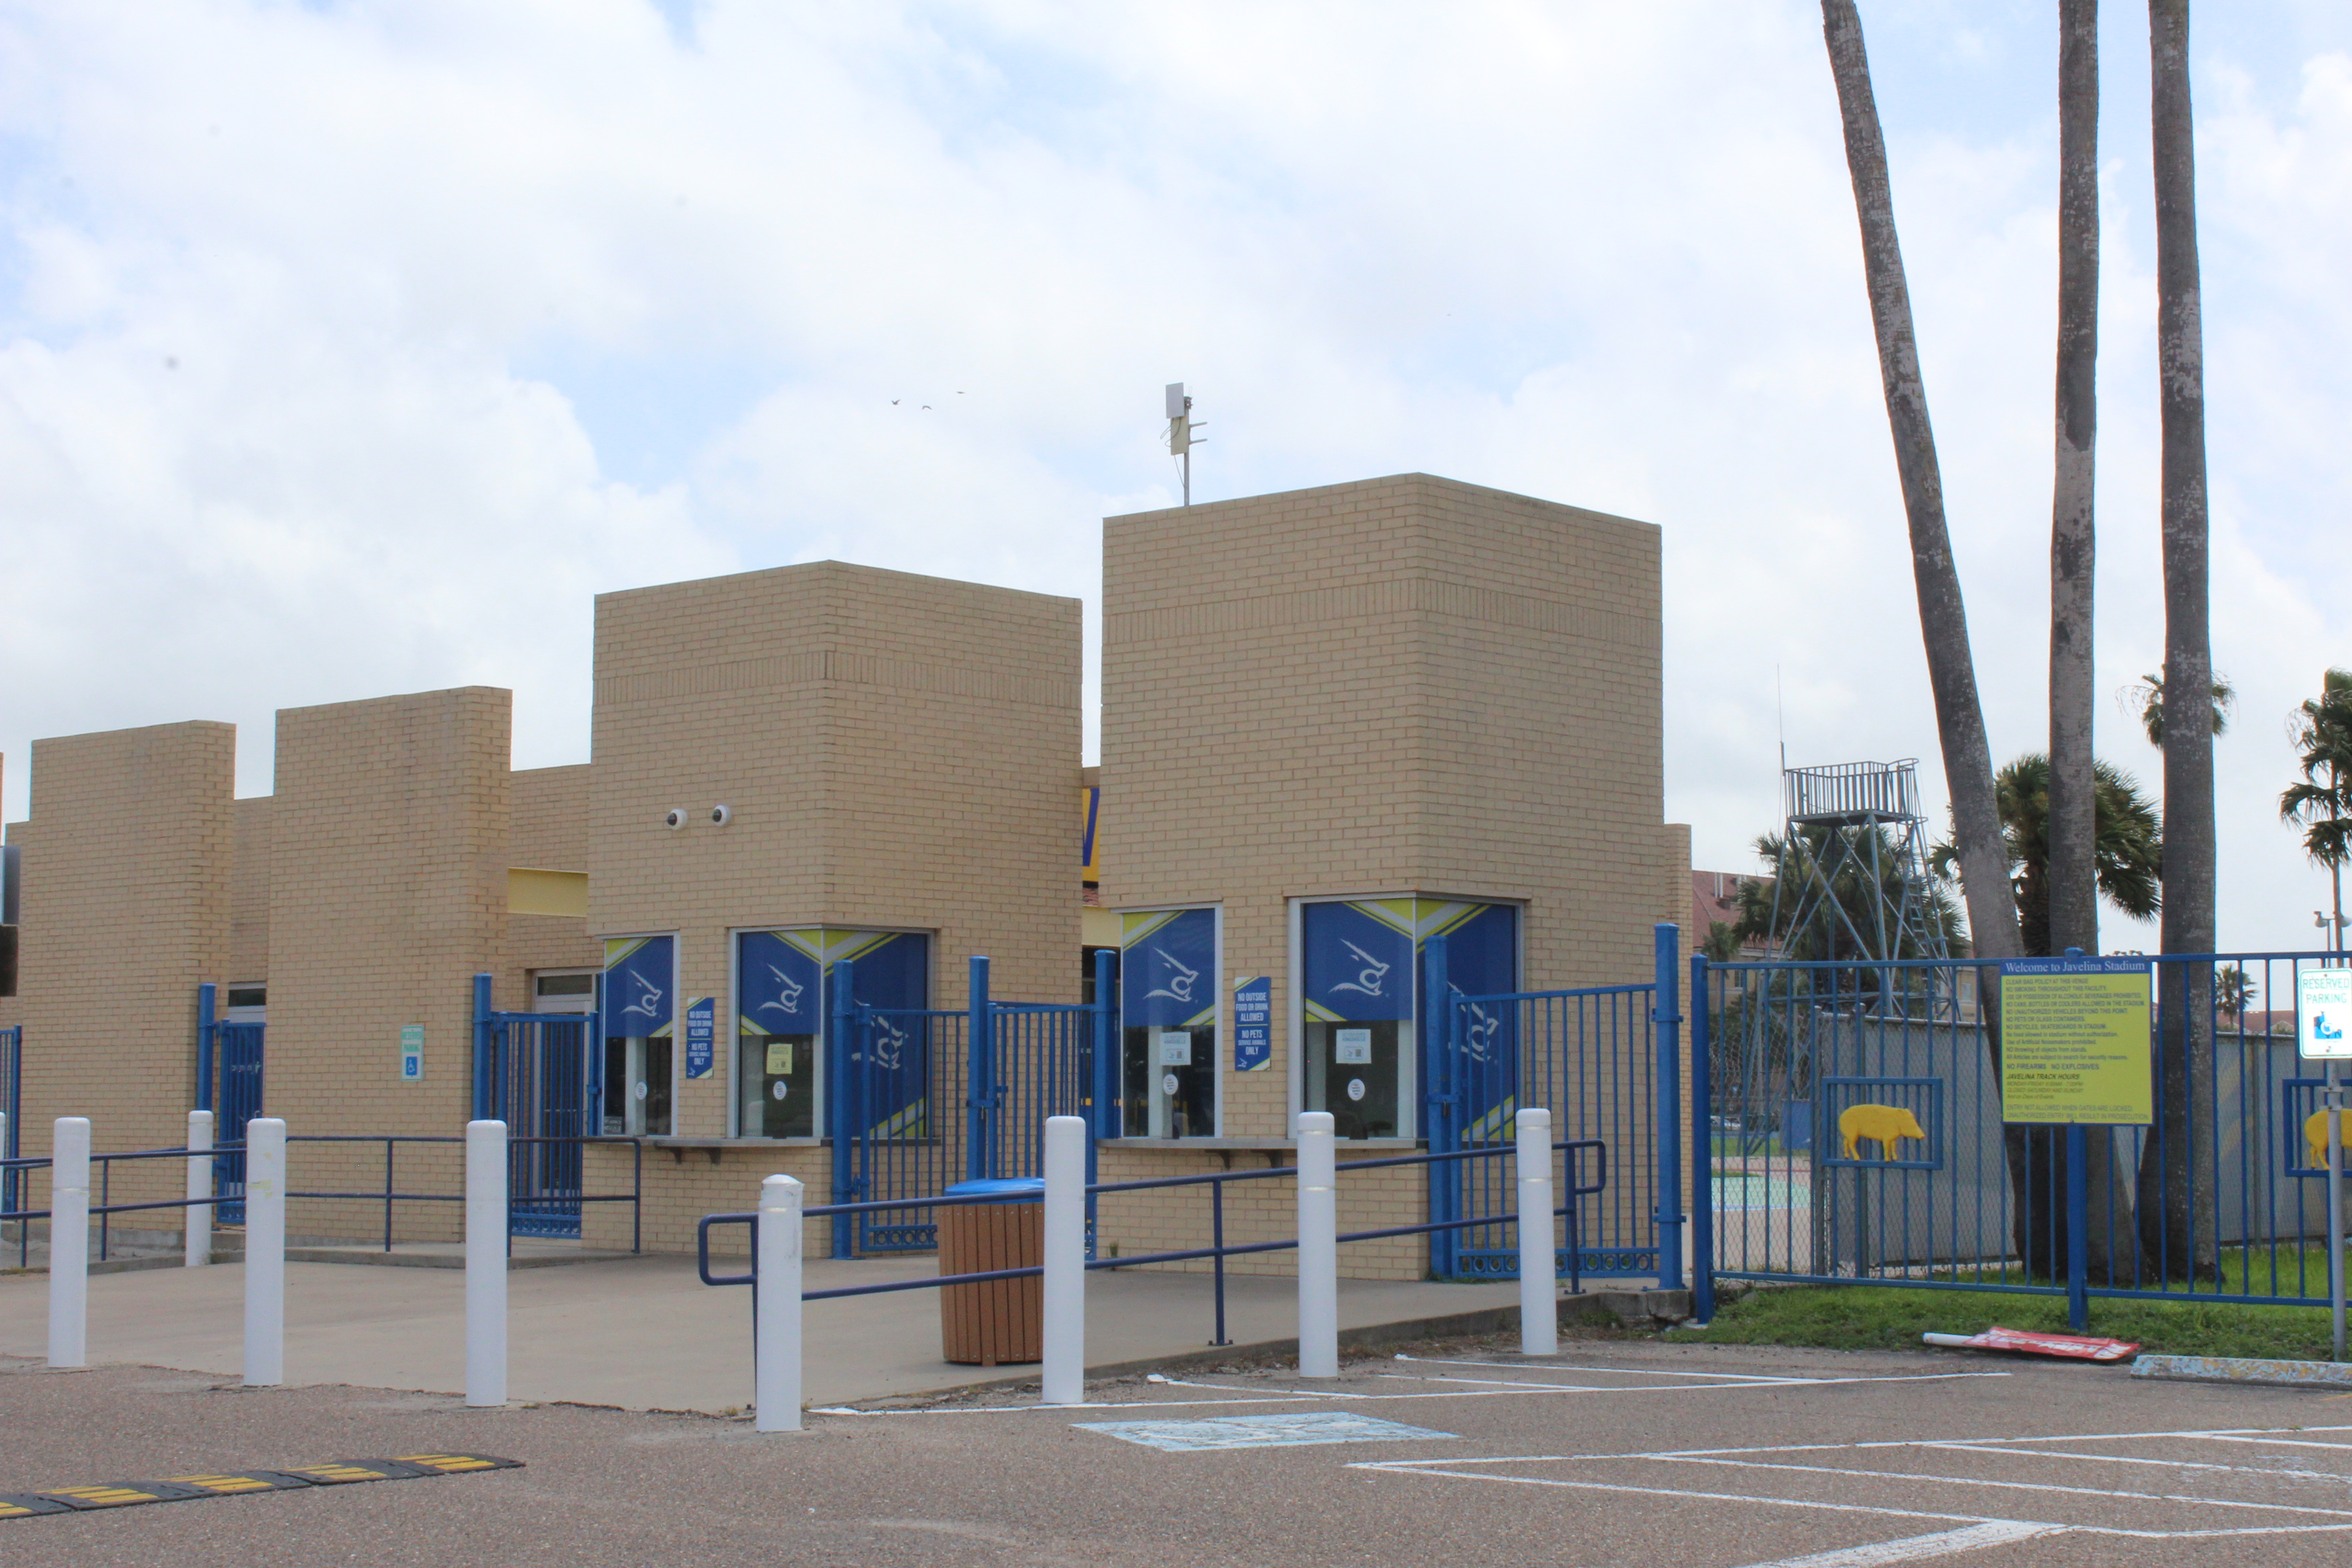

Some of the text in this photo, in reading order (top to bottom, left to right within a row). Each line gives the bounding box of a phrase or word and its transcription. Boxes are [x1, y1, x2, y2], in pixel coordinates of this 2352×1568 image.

[2006, 960, 2145, 972] Welcome to Javelina Stadium
[2303, 978, 2350, 989] RESERVED
[1238, 992, 1266, 1001] NO OUTSIDE
[2306, 993, 2347, 1004] PARKING
[696, 1010, 711, 1019] OUTSIDE
[1240, 1013, 1264, 1021] ALLOWED
[1241, 1030, 1263, 1039] NO PETS
[1245, 1046, 1259, 1055] ONLY
